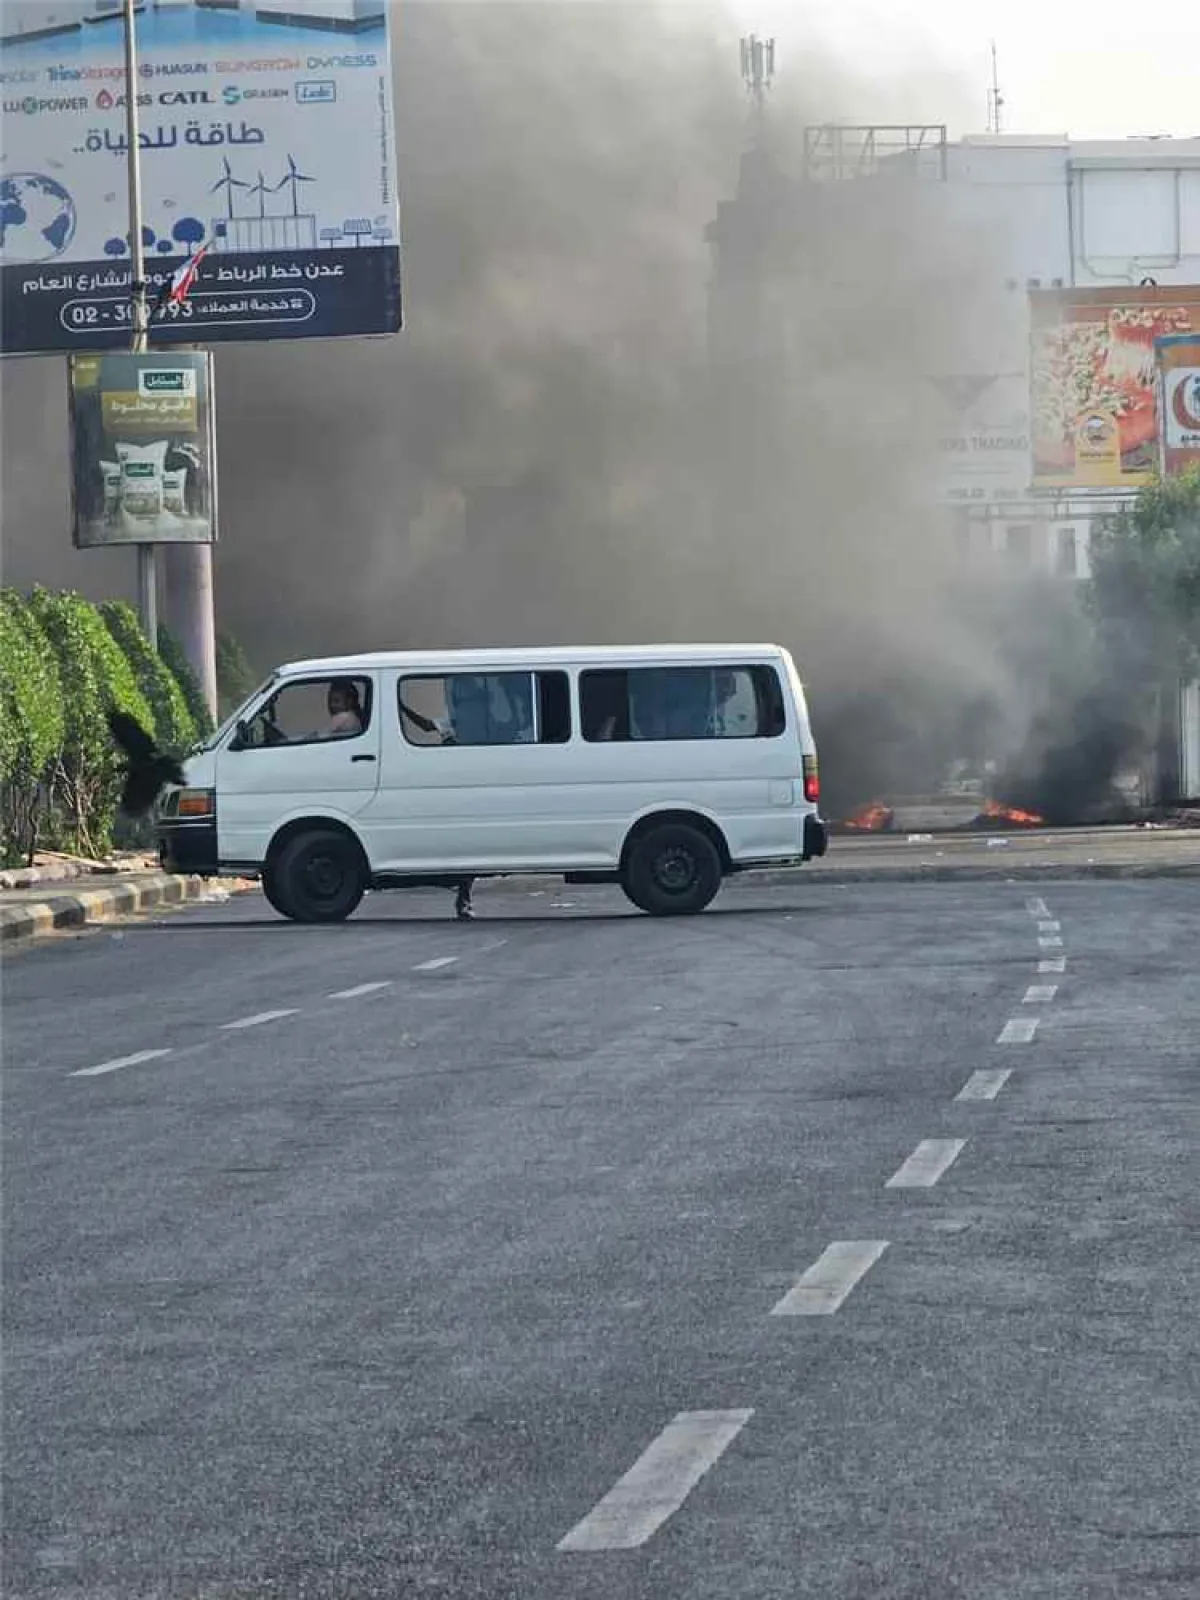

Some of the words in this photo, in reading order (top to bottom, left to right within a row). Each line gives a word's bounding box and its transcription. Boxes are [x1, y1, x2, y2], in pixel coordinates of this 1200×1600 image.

[159, 91, 216, 105] CATL
[184, 121, 265, 146] طاقة
[271, 262, 302, 279] خط
[304, 262, 345, 280] عدن
[23, 275, 73, 295] العام
[72, 306, 99, 324] 02
